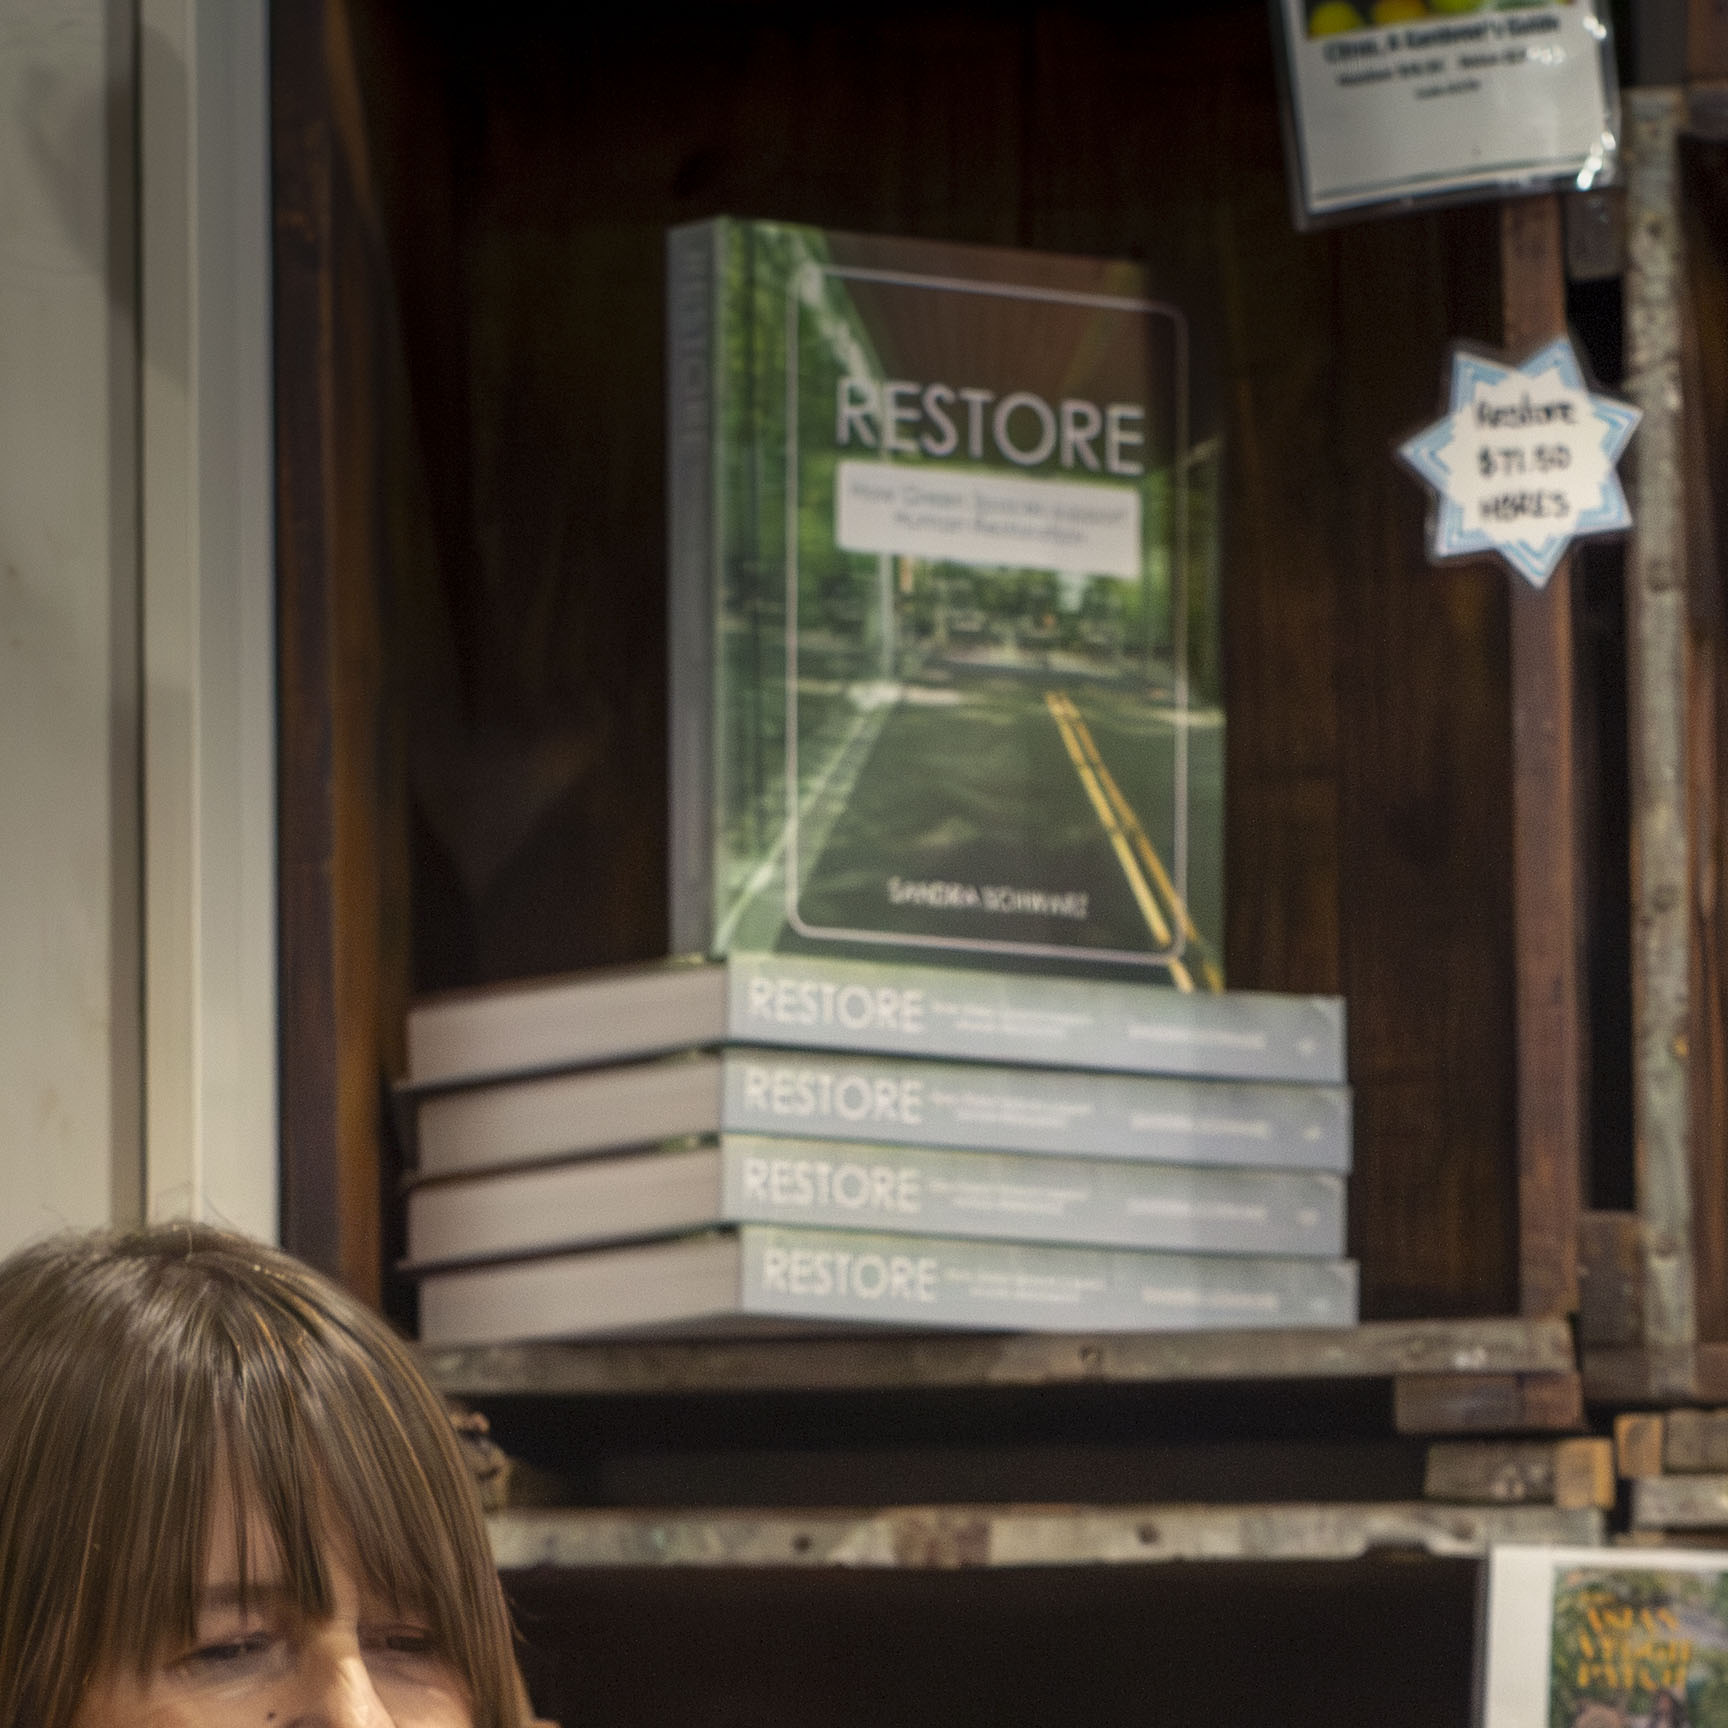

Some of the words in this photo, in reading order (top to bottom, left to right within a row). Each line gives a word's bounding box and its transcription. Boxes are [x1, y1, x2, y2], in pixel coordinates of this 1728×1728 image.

[835, 376, 1145, 475] RESTORE
[746, 976, 924, 1034] RESTORE
[743, 1069, 924, 1126] RESTORE
[741, 1155, 922, 1212] RESTORE
[762, 1250, 939, 1304] RESTORE
